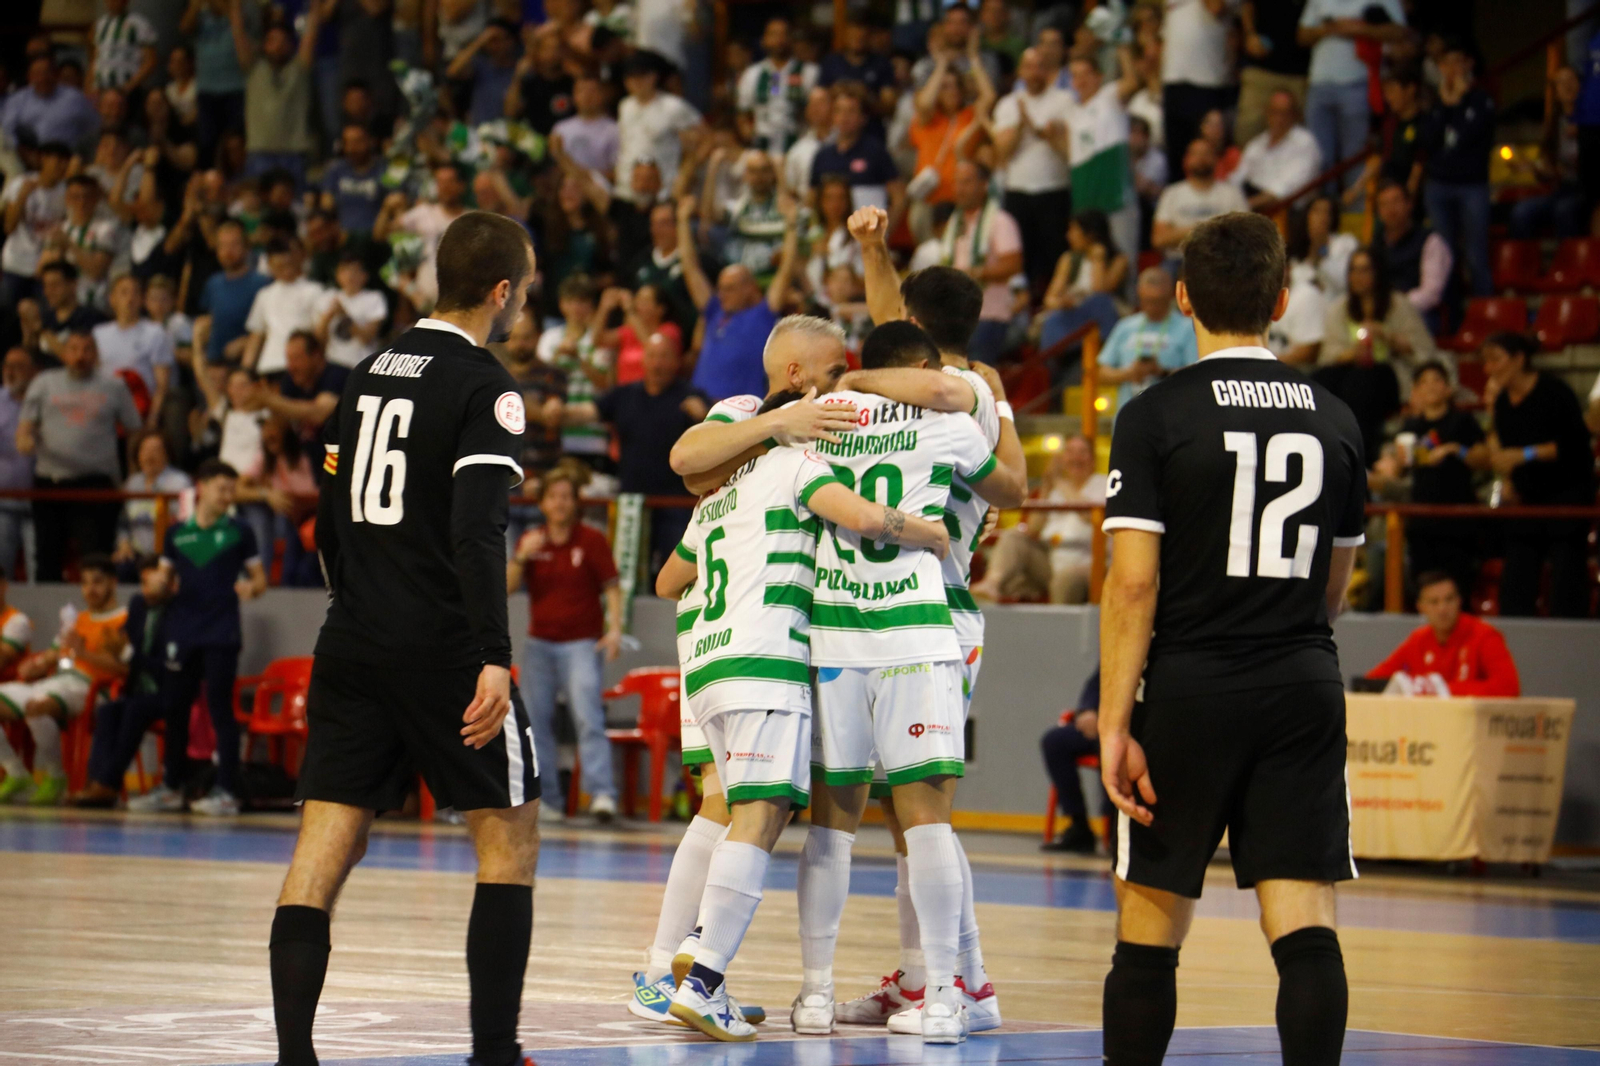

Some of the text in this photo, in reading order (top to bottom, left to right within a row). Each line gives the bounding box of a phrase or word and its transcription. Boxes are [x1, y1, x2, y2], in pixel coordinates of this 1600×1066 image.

[368, 348, 434, 378] ÁLVAREZ
[1211, 379, 1316, 411] CARDONA
[351, 394, 414, 525] 16
[1223, 431, 1324, 579] 12
[703, 525, 729, 622] 6
[694, 627, 733, 658] GUIJO
